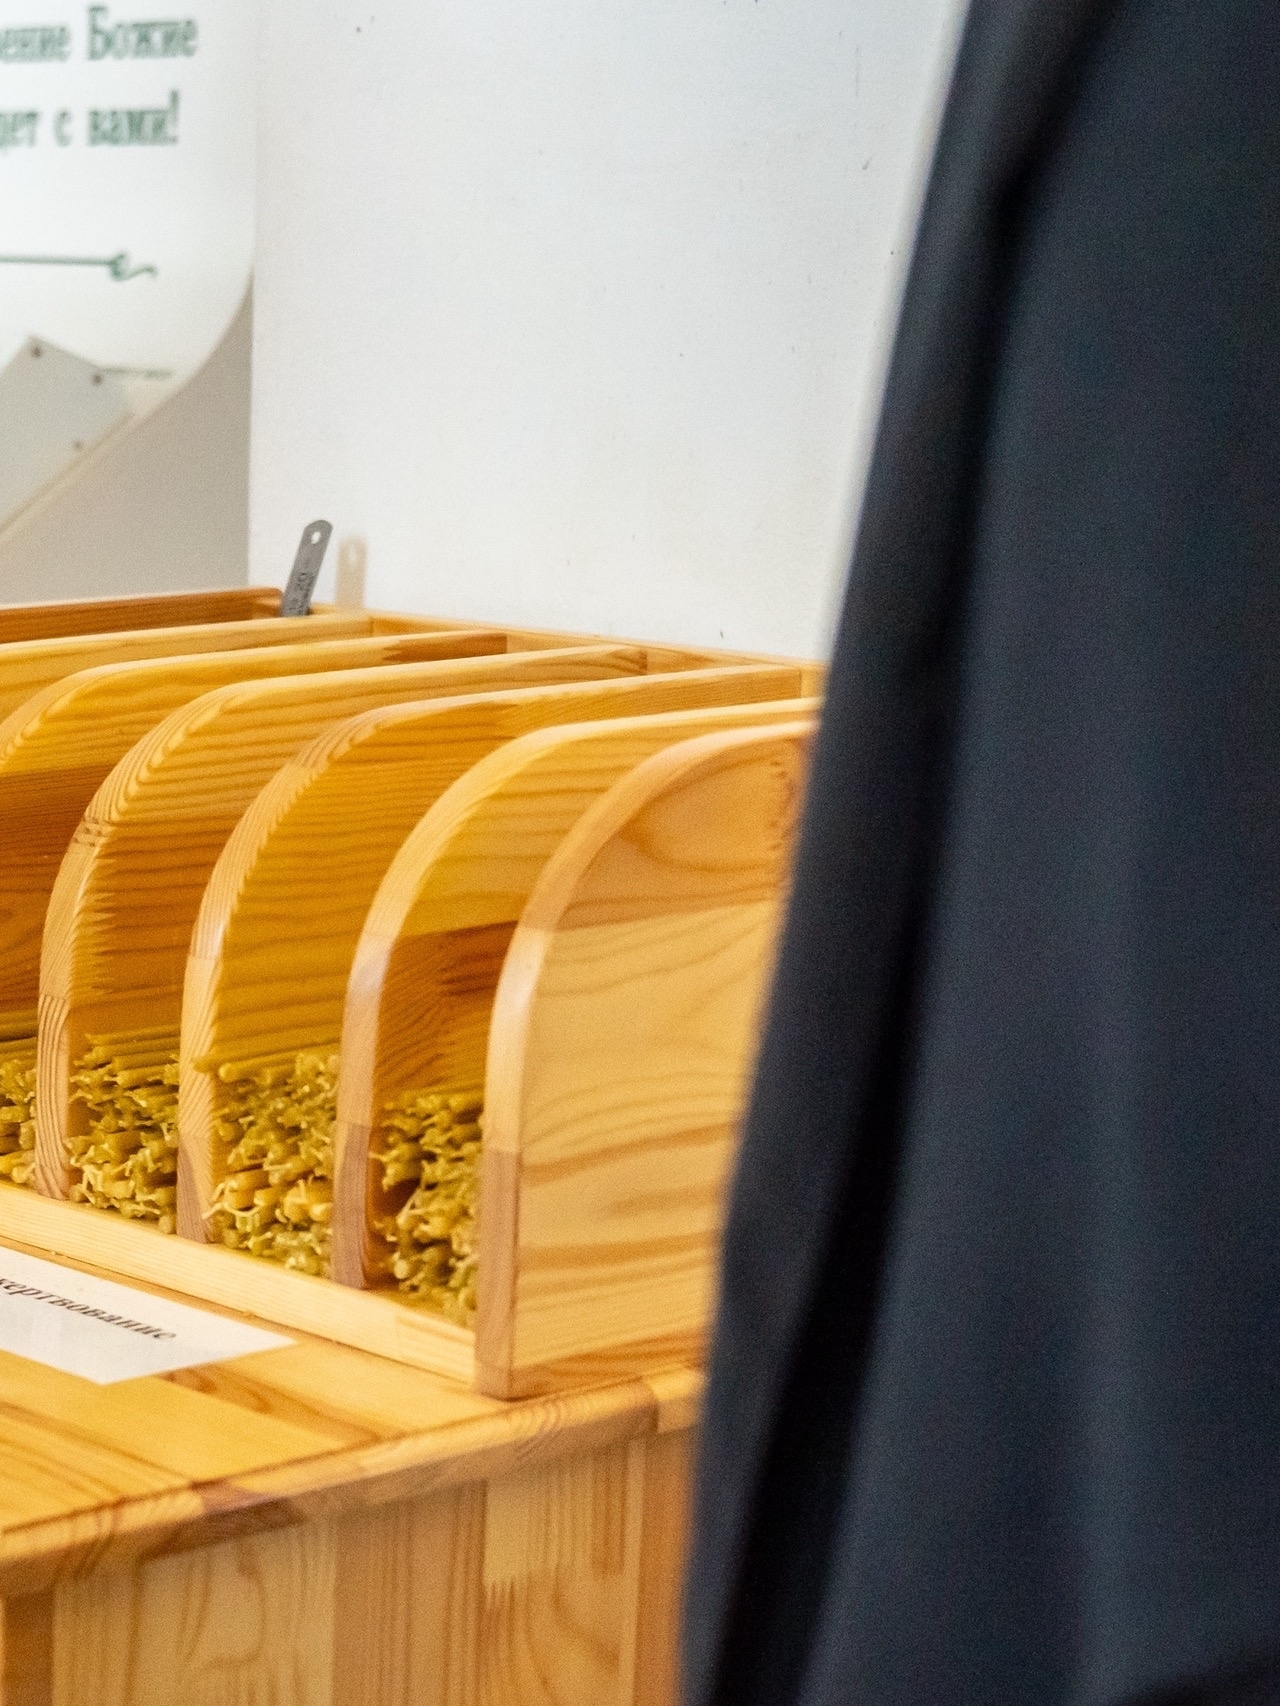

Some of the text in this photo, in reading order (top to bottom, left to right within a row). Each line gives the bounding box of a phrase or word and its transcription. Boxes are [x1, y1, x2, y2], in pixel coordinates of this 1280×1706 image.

[86, 4, 199, 61] Божие
[54, 109, 71, 147] с
[86, 88, 180, 147] вами!
